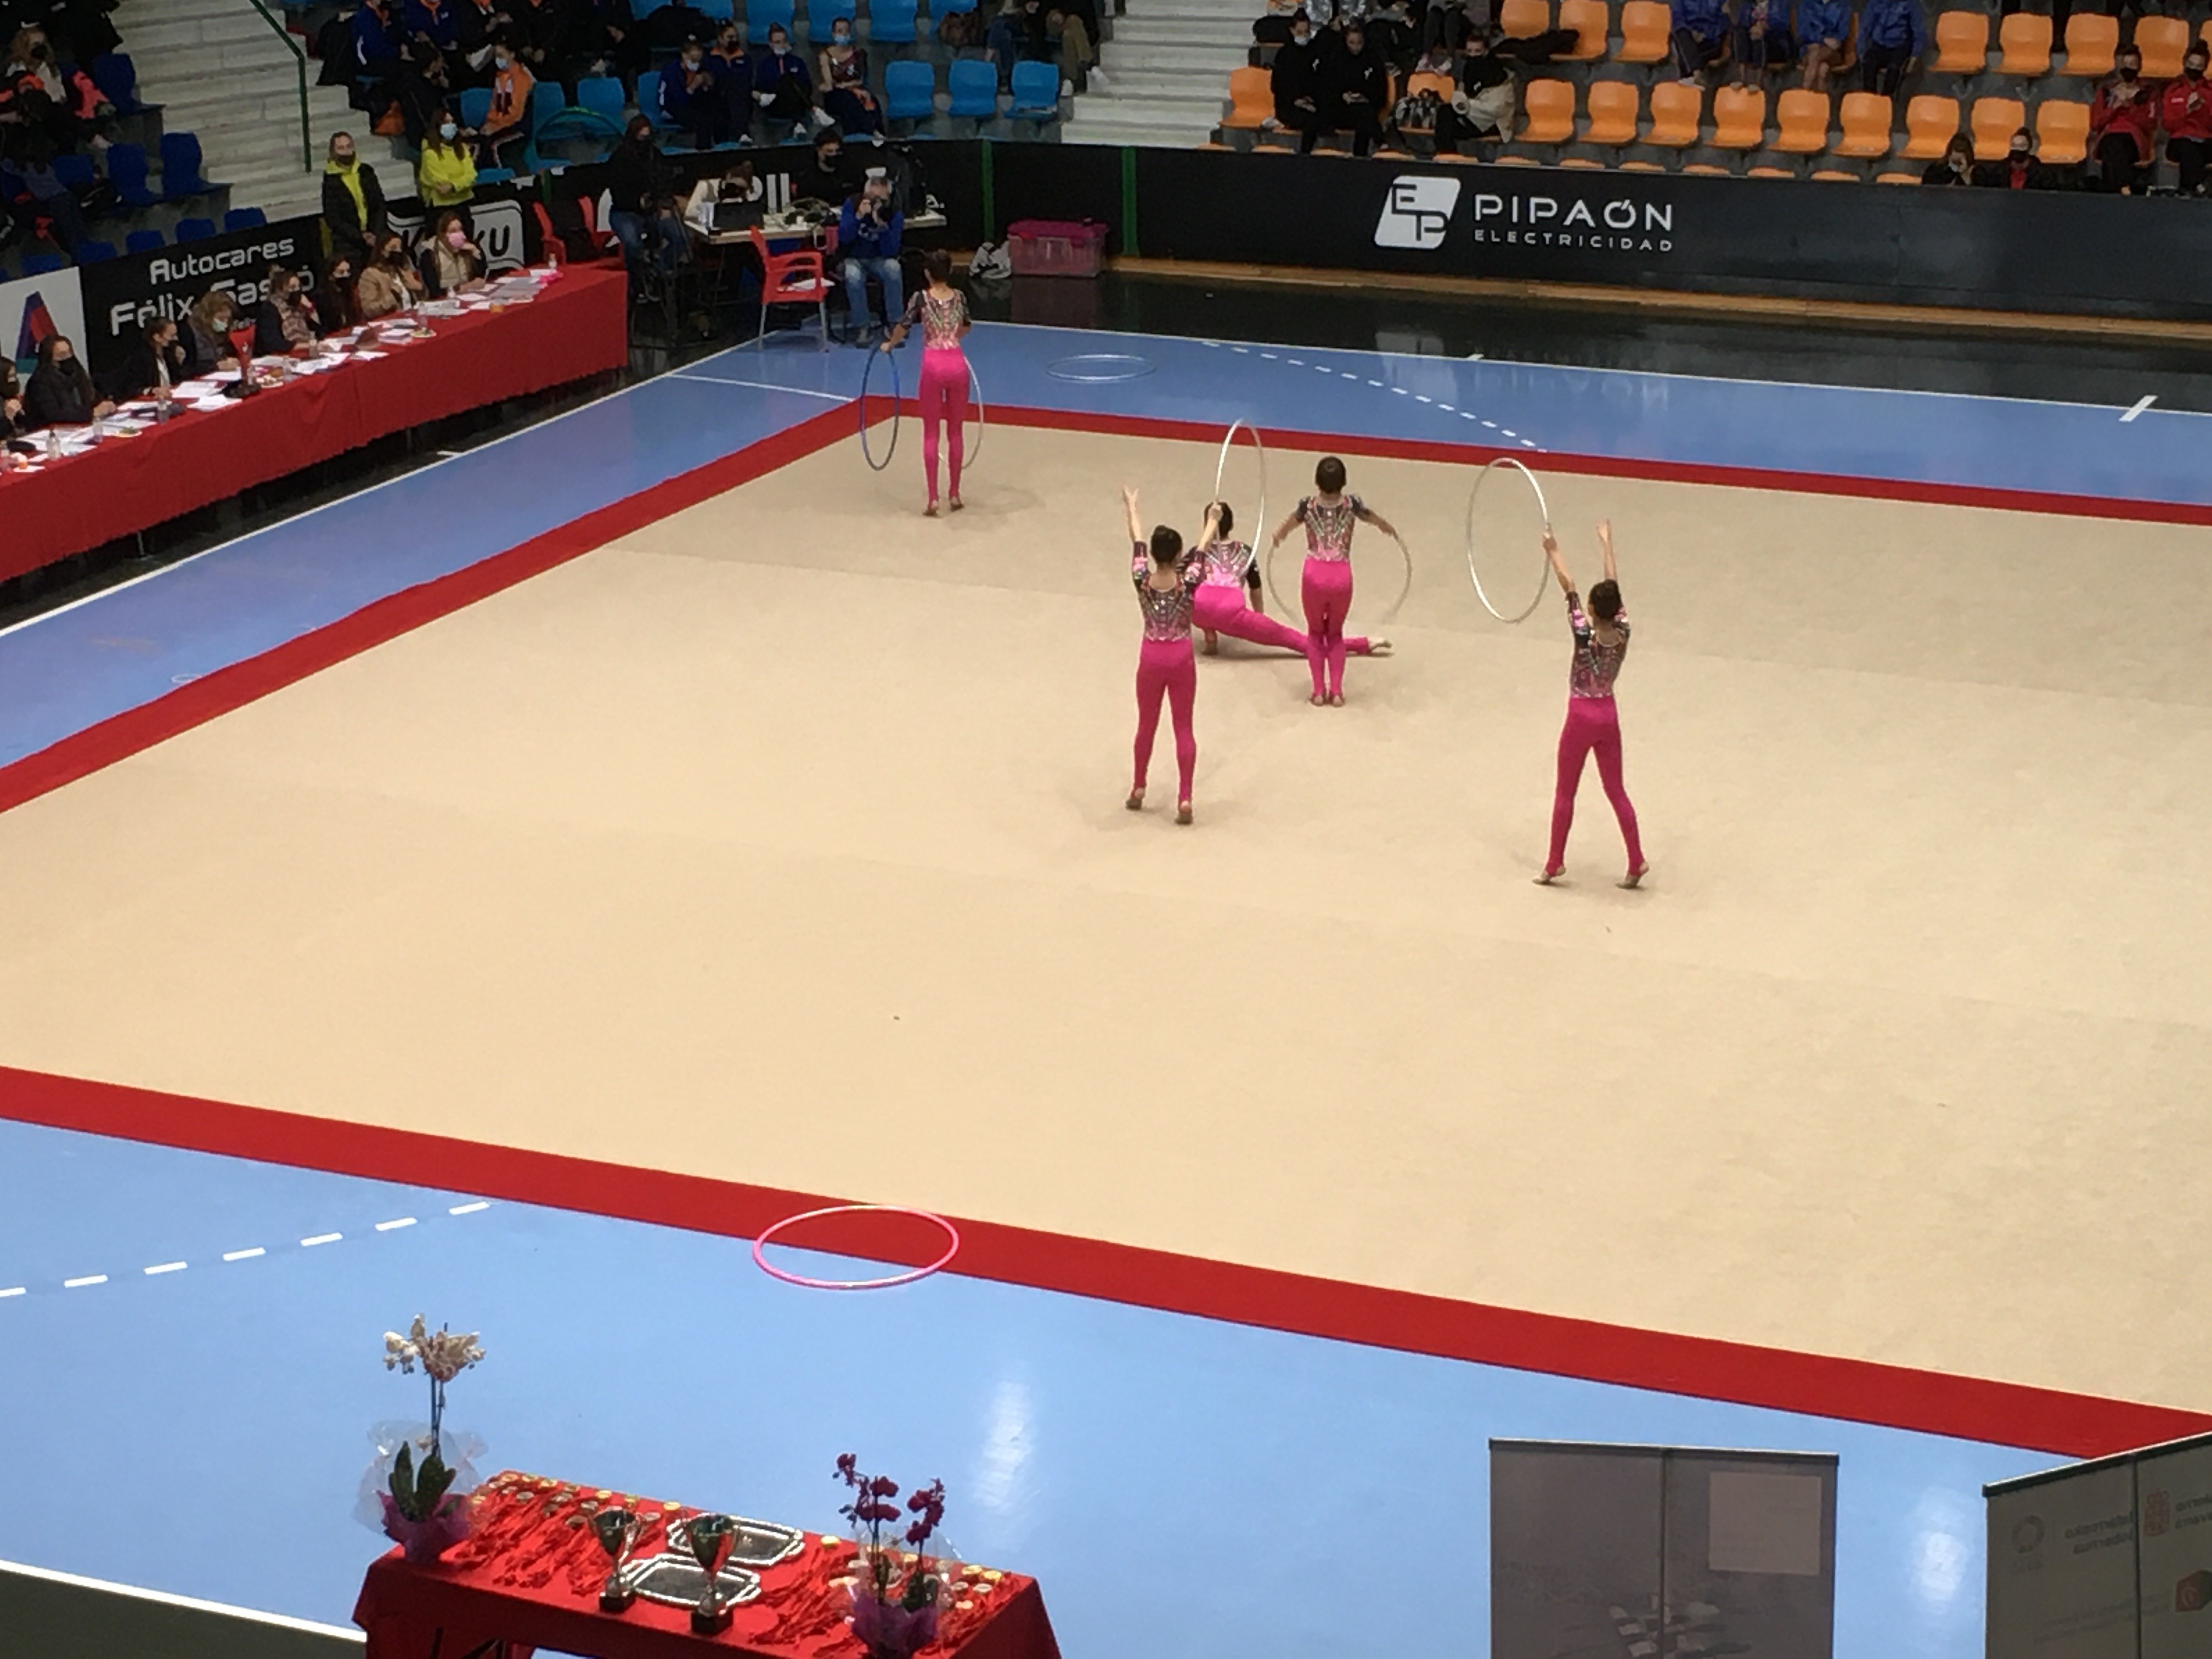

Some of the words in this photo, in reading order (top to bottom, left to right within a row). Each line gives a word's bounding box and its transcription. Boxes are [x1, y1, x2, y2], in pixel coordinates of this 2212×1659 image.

[1475, 194, 1672, 232] PIPAÓN
[1475, 229, 1672, 252] ELECTRICIDAD
[149, 238, 295, 285] Autocares
